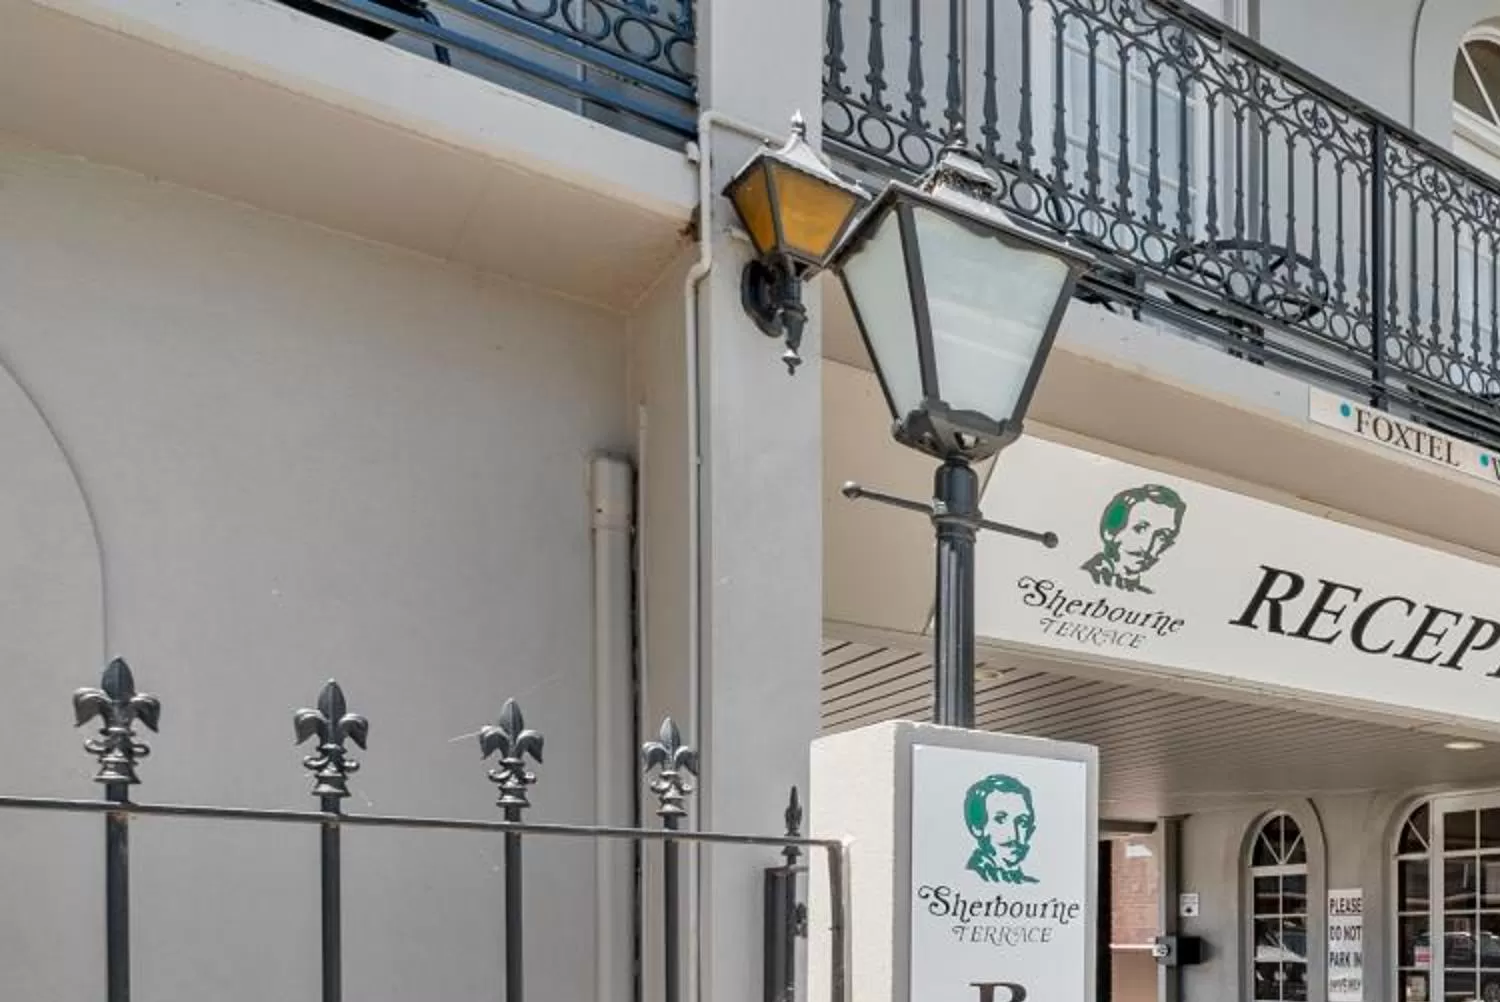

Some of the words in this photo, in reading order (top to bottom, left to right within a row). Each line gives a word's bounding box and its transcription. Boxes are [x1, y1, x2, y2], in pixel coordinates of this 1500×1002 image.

[1354, 406, 1460, 466] FOXTEL
[1017, 575, 1185, 637] Sherbourne
[1039, 617, 1147, 649] TERRACE
[917, 885, 1080, 925] Sherbourne
[1329, 897, 1362, 913] PLEASE
[952, 925, 1053, 947] TERRACE
[1329, 925, 1342, 941] DO
[1343, 925, 1362, 941] NOT
[1329, 952, 1351, 967] PARK
